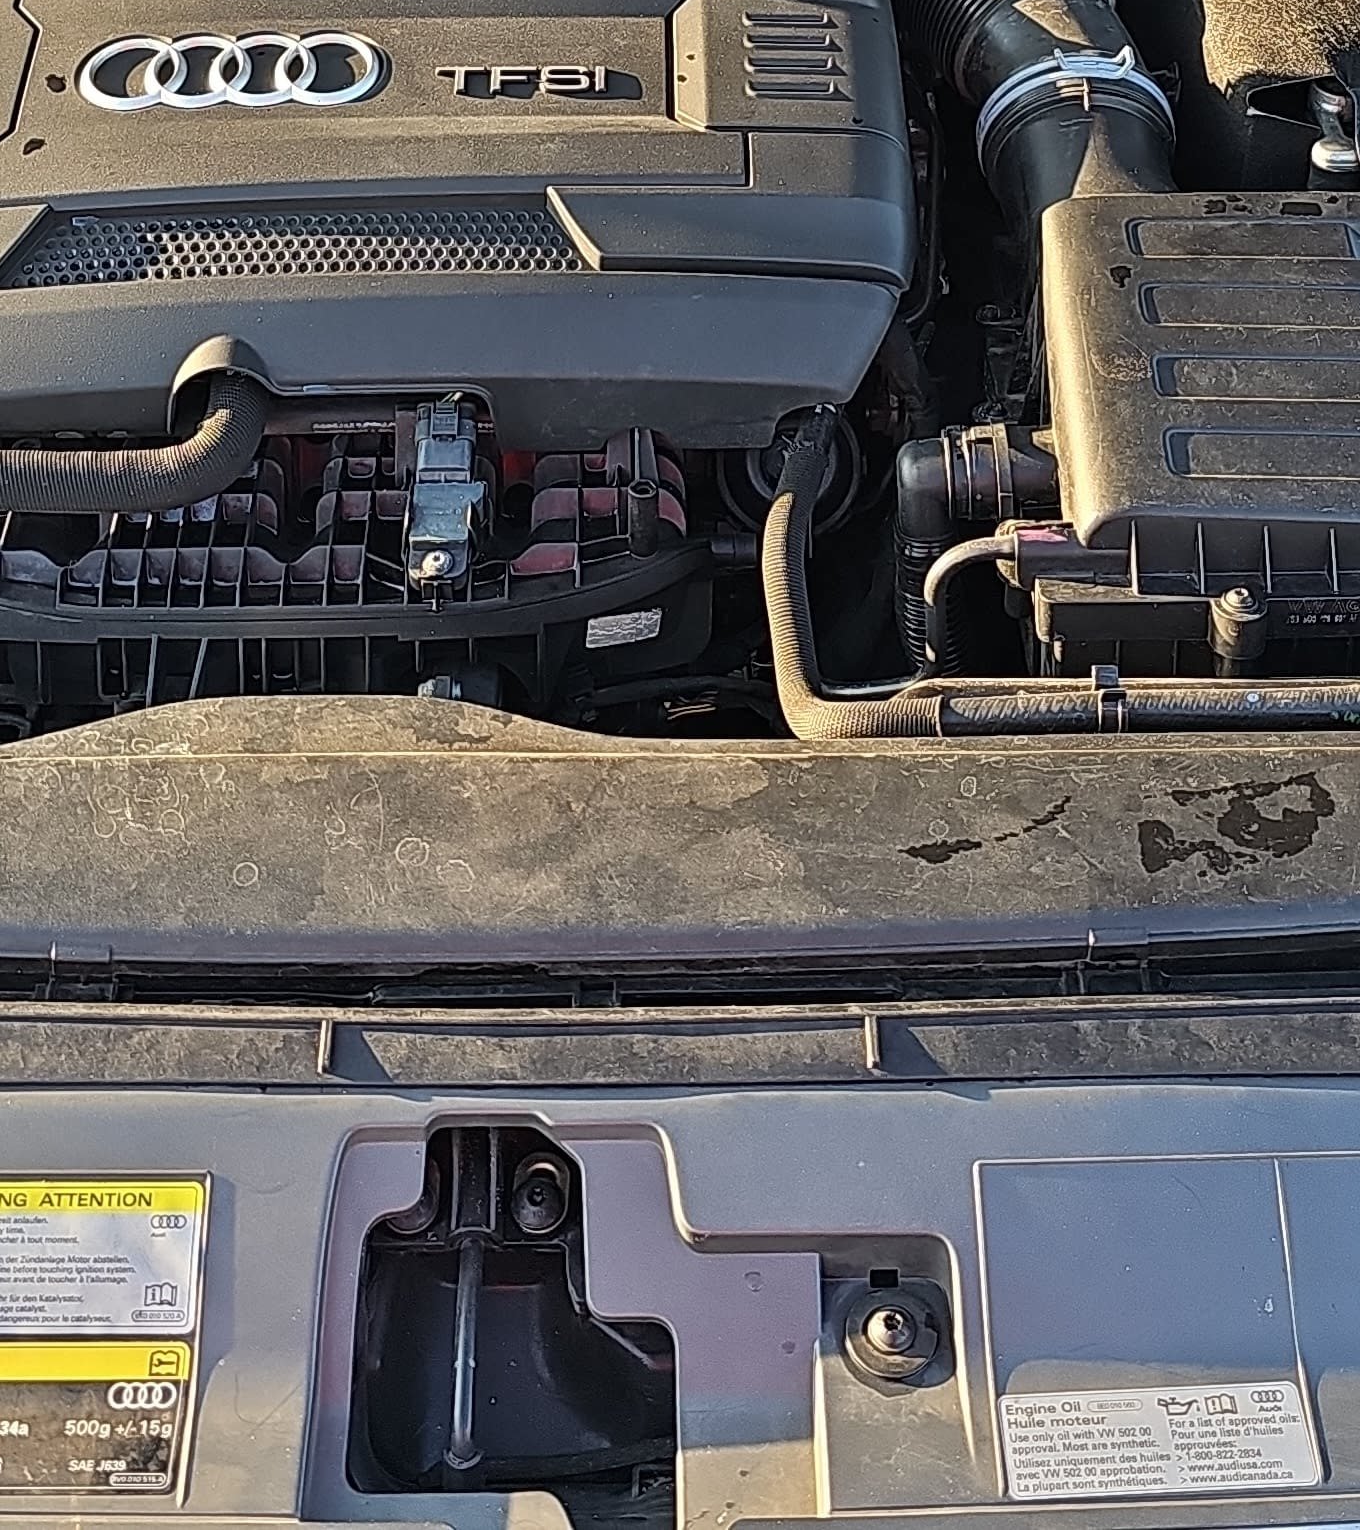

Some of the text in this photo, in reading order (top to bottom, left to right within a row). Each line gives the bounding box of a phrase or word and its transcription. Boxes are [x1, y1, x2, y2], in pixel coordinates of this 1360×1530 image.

[436, 66, 607, 95] TFSI
[39, 1191, 152, 1208] ATTENTION
[5, 1255, 18, 1263] der
[66, 1255, 91, 1264] Motor
[12, 1264, 37, 1273] before
[38, 1265, 73, 1275] touching
[74, 1265, 104, 1275] ignition
[35, 1275, 46, 1283] de
[47, 1275, 77, 1283] toucher
[8, 1293, 20, 1302] für
[21, 1294, 37, 1302] den
[40, 1315, 60, 1323] pour
[61, 1314, 69, 1322] le
[1004, 1402, 1056, 1417] Engine
[1060, 1400, 1081, 1412] Oil
[1257, 1404, 1282, 1412] Audi
[1006, 1415, 1107, 1429] Huile moteur
[1167, 1418, 1186, 1428] For
[1196, 1416, 1213, 1427] list
[1214, 1416, 1225, 1426] of
[1228, 1413, 1276, 1426] approved
[1278, 1412, 1300, 1423] oils:
[64, 1419, 111, 1439] 500g
[1008, 1426, 1151, 1443] Use only oil with VW 502 00
[1170, 1424, 1284, 1439] Pour une liste d'huiles
[1011, 1437, 1160, 1456] approval. Most are synthetic.
[68, 1459, 94, 1471] SAE
[97, 1460, 127, 1471] J639
[1013, 1451, 1171, 1469] Utilisez uniquement des huiles
[1186, 1459, 1282, 1472] www.audiusa.com
[1015, 1463, 1166, 1480] avec VW 502 00 approbation.
[1188, 1469, 1293, 1483] www.audicanada.ca
[1016, 1476, 1167, 1493] La plupart sont synthétiques.
